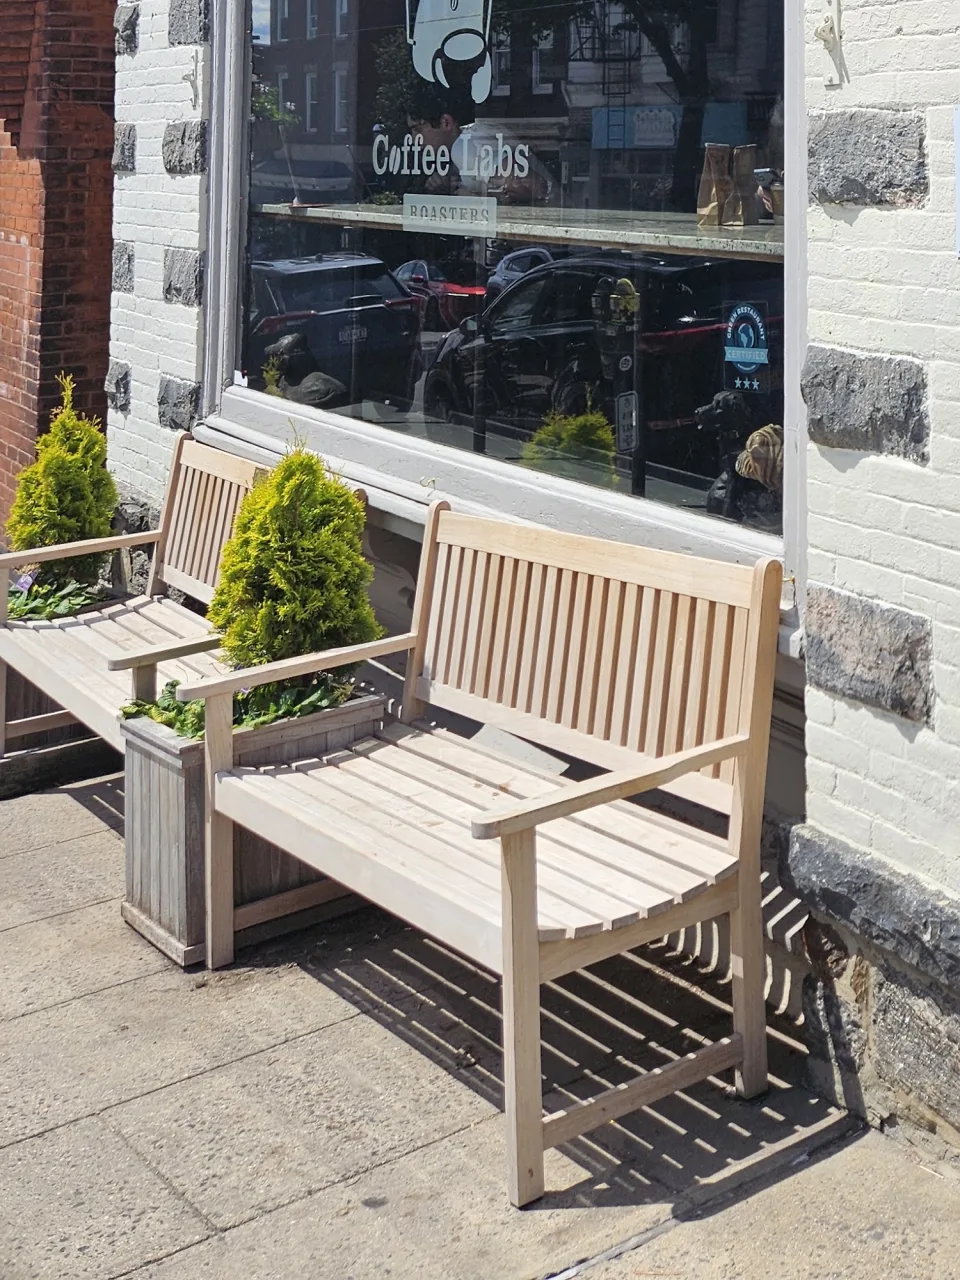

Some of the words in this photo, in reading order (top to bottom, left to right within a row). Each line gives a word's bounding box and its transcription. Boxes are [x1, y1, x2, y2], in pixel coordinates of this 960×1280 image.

[372, 133, 450, 177] Coffee
[458, 133, 529, 178] Labs
[409, 204, 490, 224] ROASTERS
[726, 313, 738, 339] GREEN
[736, 306, 765, 341] RESTAURANT
[726, 350, 766, 360] CERTIFIED
